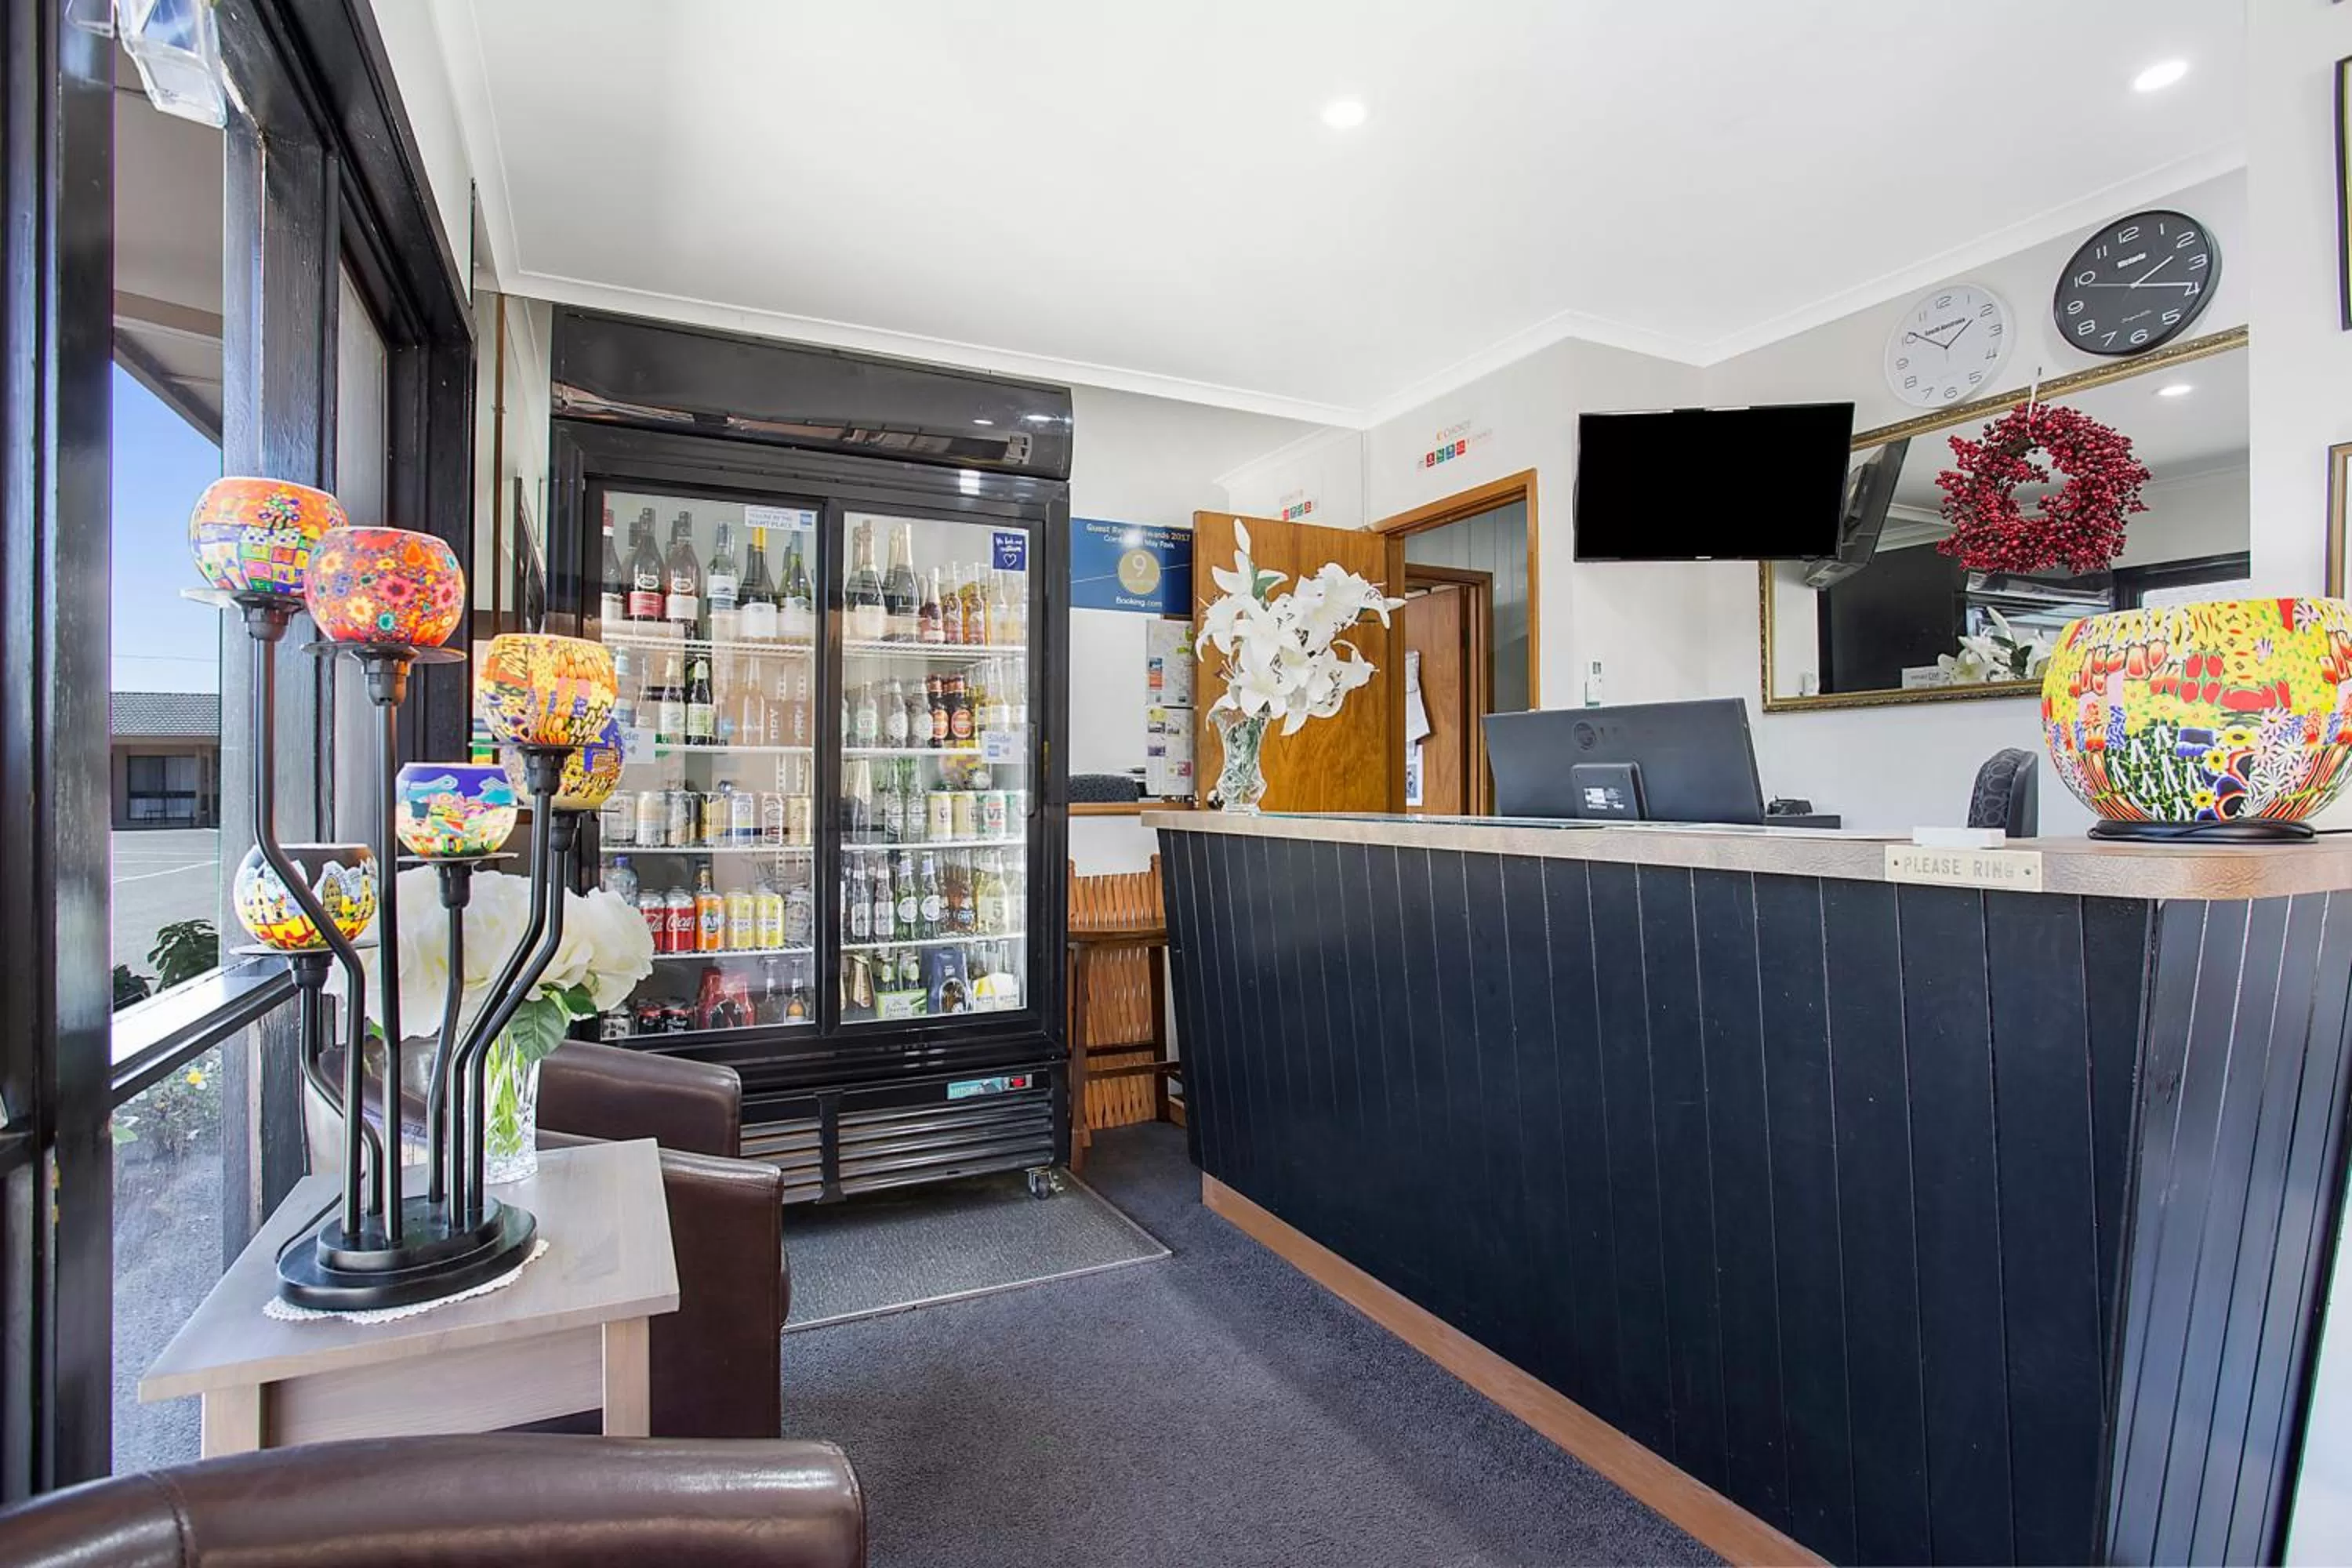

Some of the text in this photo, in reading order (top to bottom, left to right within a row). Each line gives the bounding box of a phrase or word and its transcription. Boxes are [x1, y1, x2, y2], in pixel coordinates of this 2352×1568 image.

[2118, 226, 2140, 244] 12
[2159, 223, 2164, 236] 1
[2176, 230, 2196, 249] 2
[2096, 245, 2107, 260] 11
[2188, 252, 2208, 270] 3
[2074, 270, 2096, 288] 10
[2183, 281, 2200, 297] 4
[1934, 296, 1952, 310] 12
[1966, 294, 1971, 305] 1
[1980, 303, 1995, 318] 2
[2067, 300, 2084, 314] 9
[1918, 310, 1928, 322] 11
[2161, 308, 2182, 325] 5
[1989, 323, 2002, 337] 3
[2077, 319, 2096, 336] 8
[1901, 332, 1917, 346] 10
[2101, 330, 2118, 347] 7
[2129, 328, 2148, 345] 6
[1984, 347, 1998, 360] 4
[1895, 357, 1909, 370] 9
[1904, 376, 1917, 390] 8
[1969, 371, 1983, 385] 5
[1920, 387, 1935, 401] 7
[1944, 386, 1958, 399] 6
[1086, 523, 1110, 532] Guest
[1132, 554, 1148, 578] 9
[1903, 856, 2016, 880] PLEASE RING
